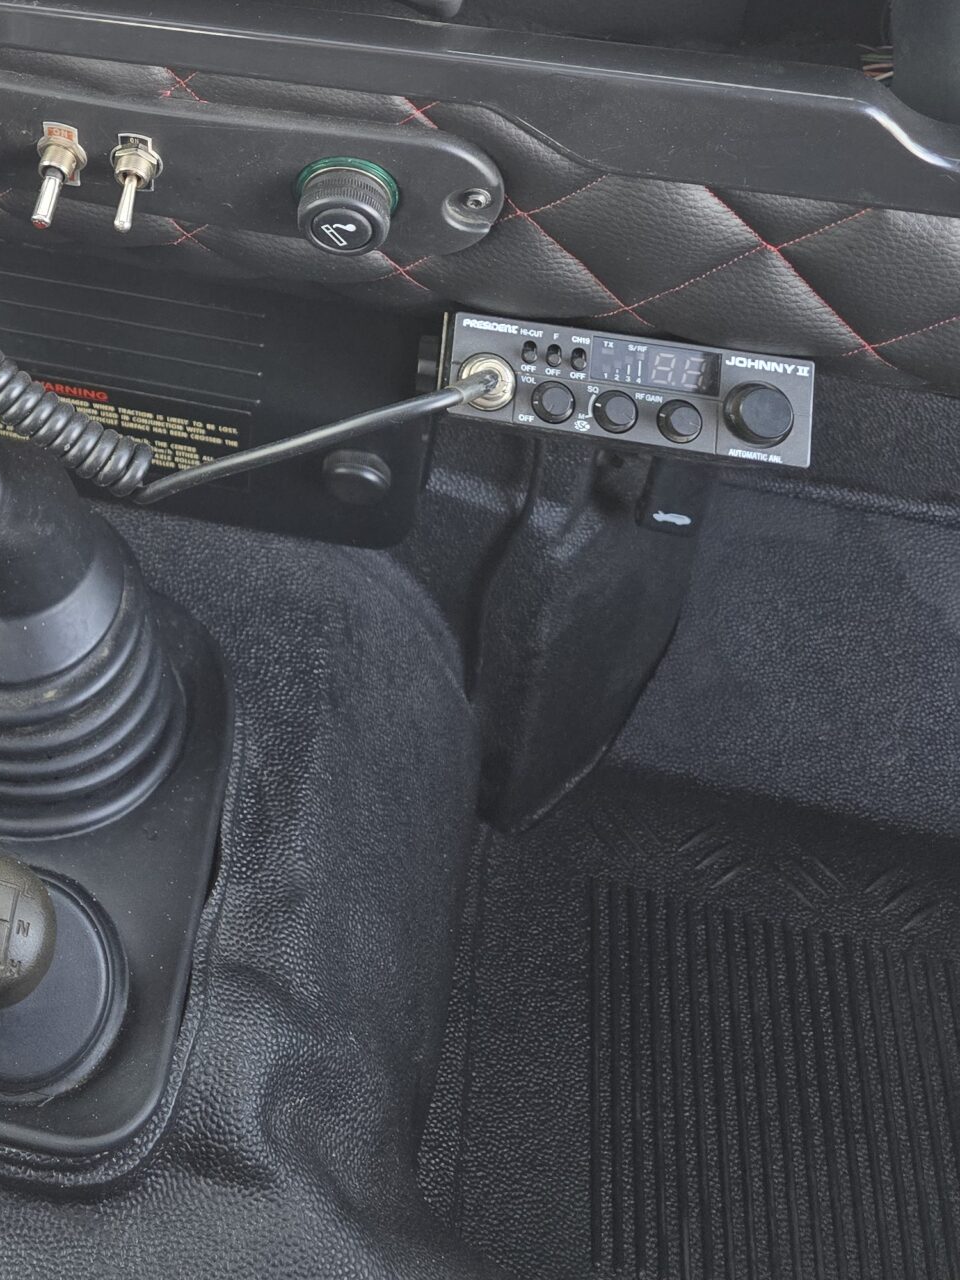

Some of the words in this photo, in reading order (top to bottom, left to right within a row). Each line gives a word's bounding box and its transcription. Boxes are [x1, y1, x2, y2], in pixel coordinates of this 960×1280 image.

[463, 318, 519, 335] PRESIDENT
[571, 336, 591, 345] CH19
[520, 365, 537, 373] OFF
[725, 356, 796, 375] JOHNNY
[545, 368, 561, 377] OFF
[569, 372, 586, 380] OFF
[521, 375, 537, 385] VOL
[587, 385, 600, 394] SQ
[645, 394, 663, 404] GAIN
[118, 407, 154, 419] TRACTION
[167, 416, 189, 425] LIKELY
[518, 414, 535, 422] OFF
[121, 420, 150, 432] SURFACE
[190, 433, 223, 444] CROSSED
[225, 439, 238, 448] THE
[728, 448, 768, 462] AUTOMATIC
[768, 454, 783, 464] ANL
[16, 919, 31, 938] N
